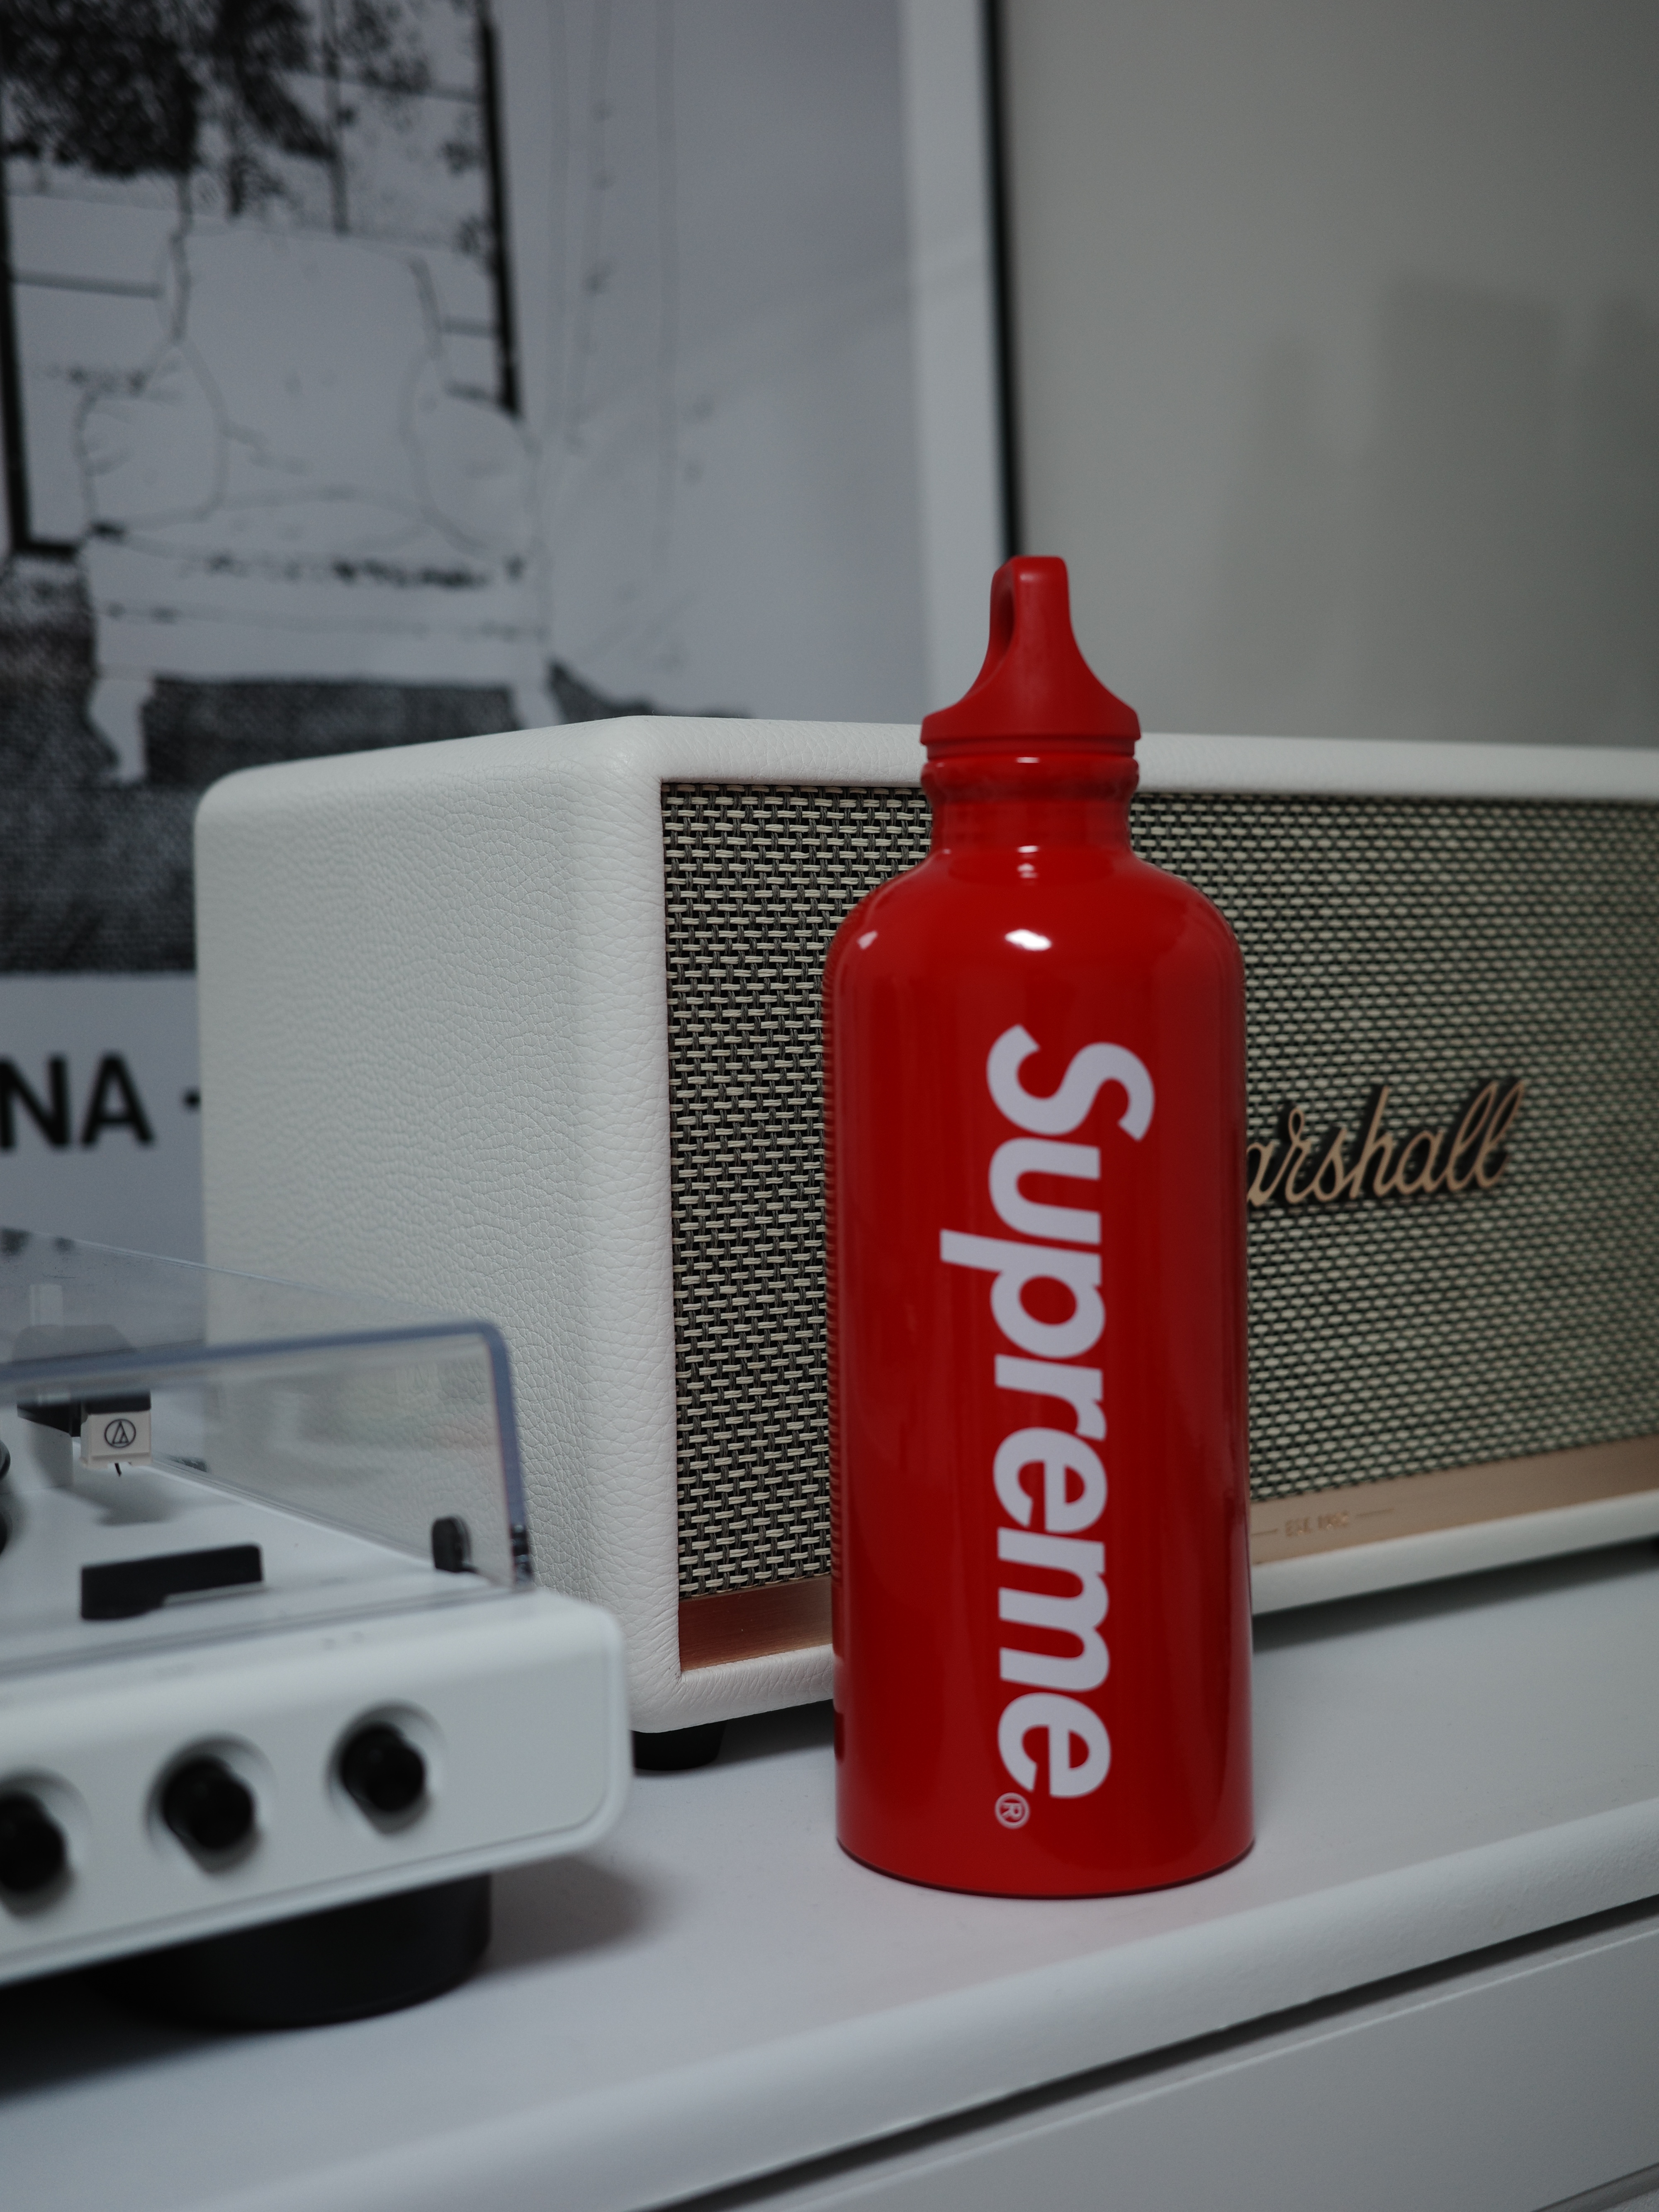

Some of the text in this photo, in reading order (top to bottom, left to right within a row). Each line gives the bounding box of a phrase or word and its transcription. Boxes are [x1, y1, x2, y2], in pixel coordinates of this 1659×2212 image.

[0, 1052, 155, 1153] NA
[1246, 1080, 1525, 1207] arshall
[940, 1024, 1154, 1799] Supreme
